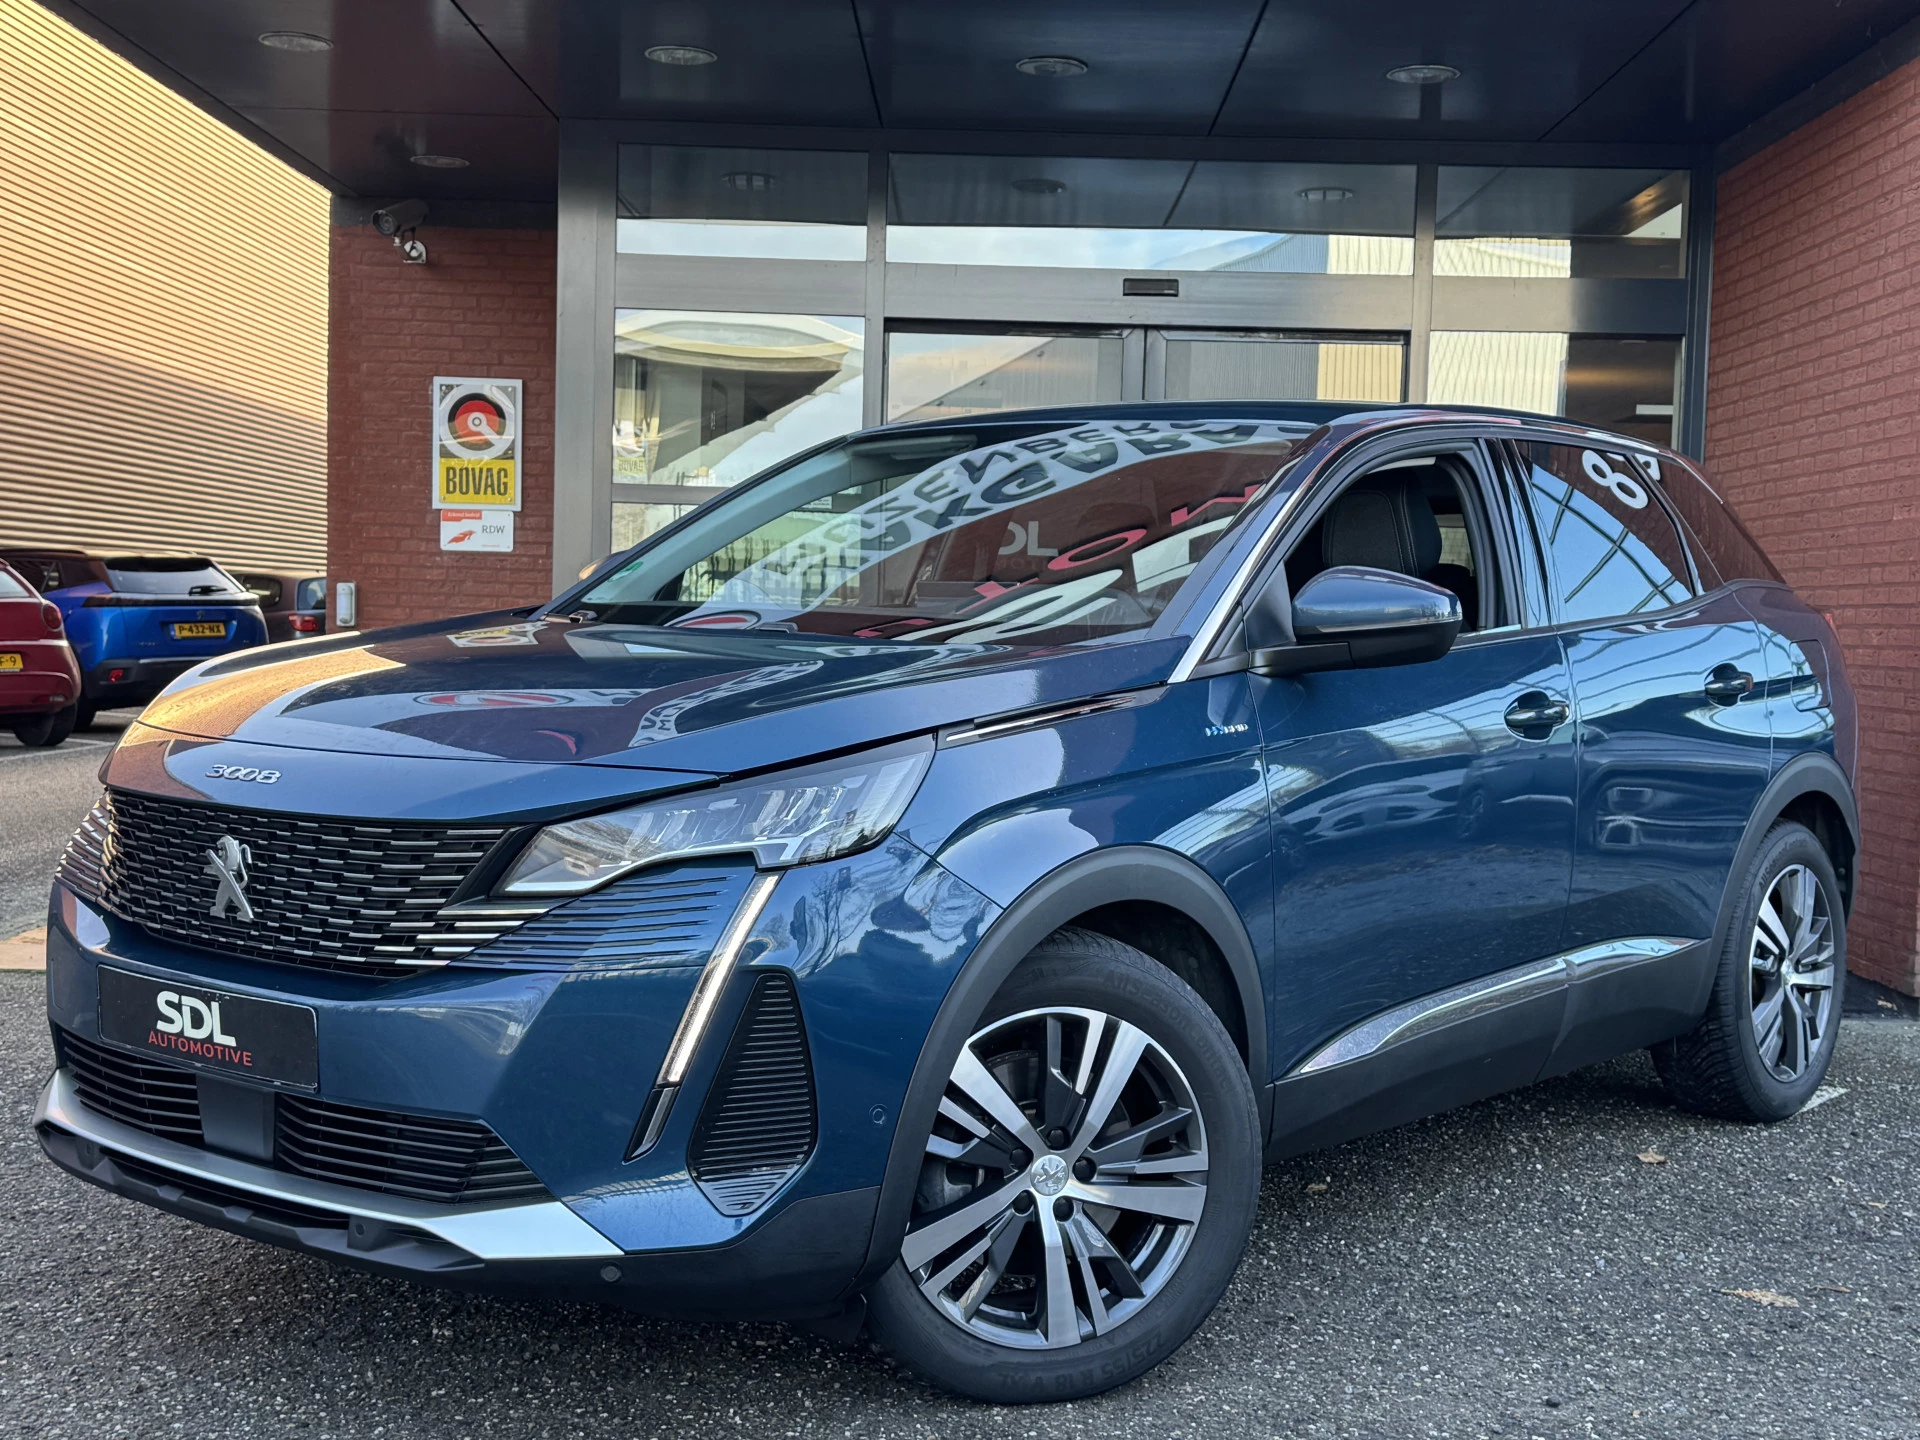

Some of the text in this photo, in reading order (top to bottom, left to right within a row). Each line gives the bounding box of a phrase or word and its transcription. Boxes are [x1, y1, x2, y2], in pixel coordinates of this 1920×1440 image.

[446, 467, 508, 496] BOVAG
[482, 525, 505, 534] RDW
[205, 764, 281, 784] 3008
[156, 990, 237, 1047] SDL
[148, 1031, 253, 1067] AUTOMOTIVE
